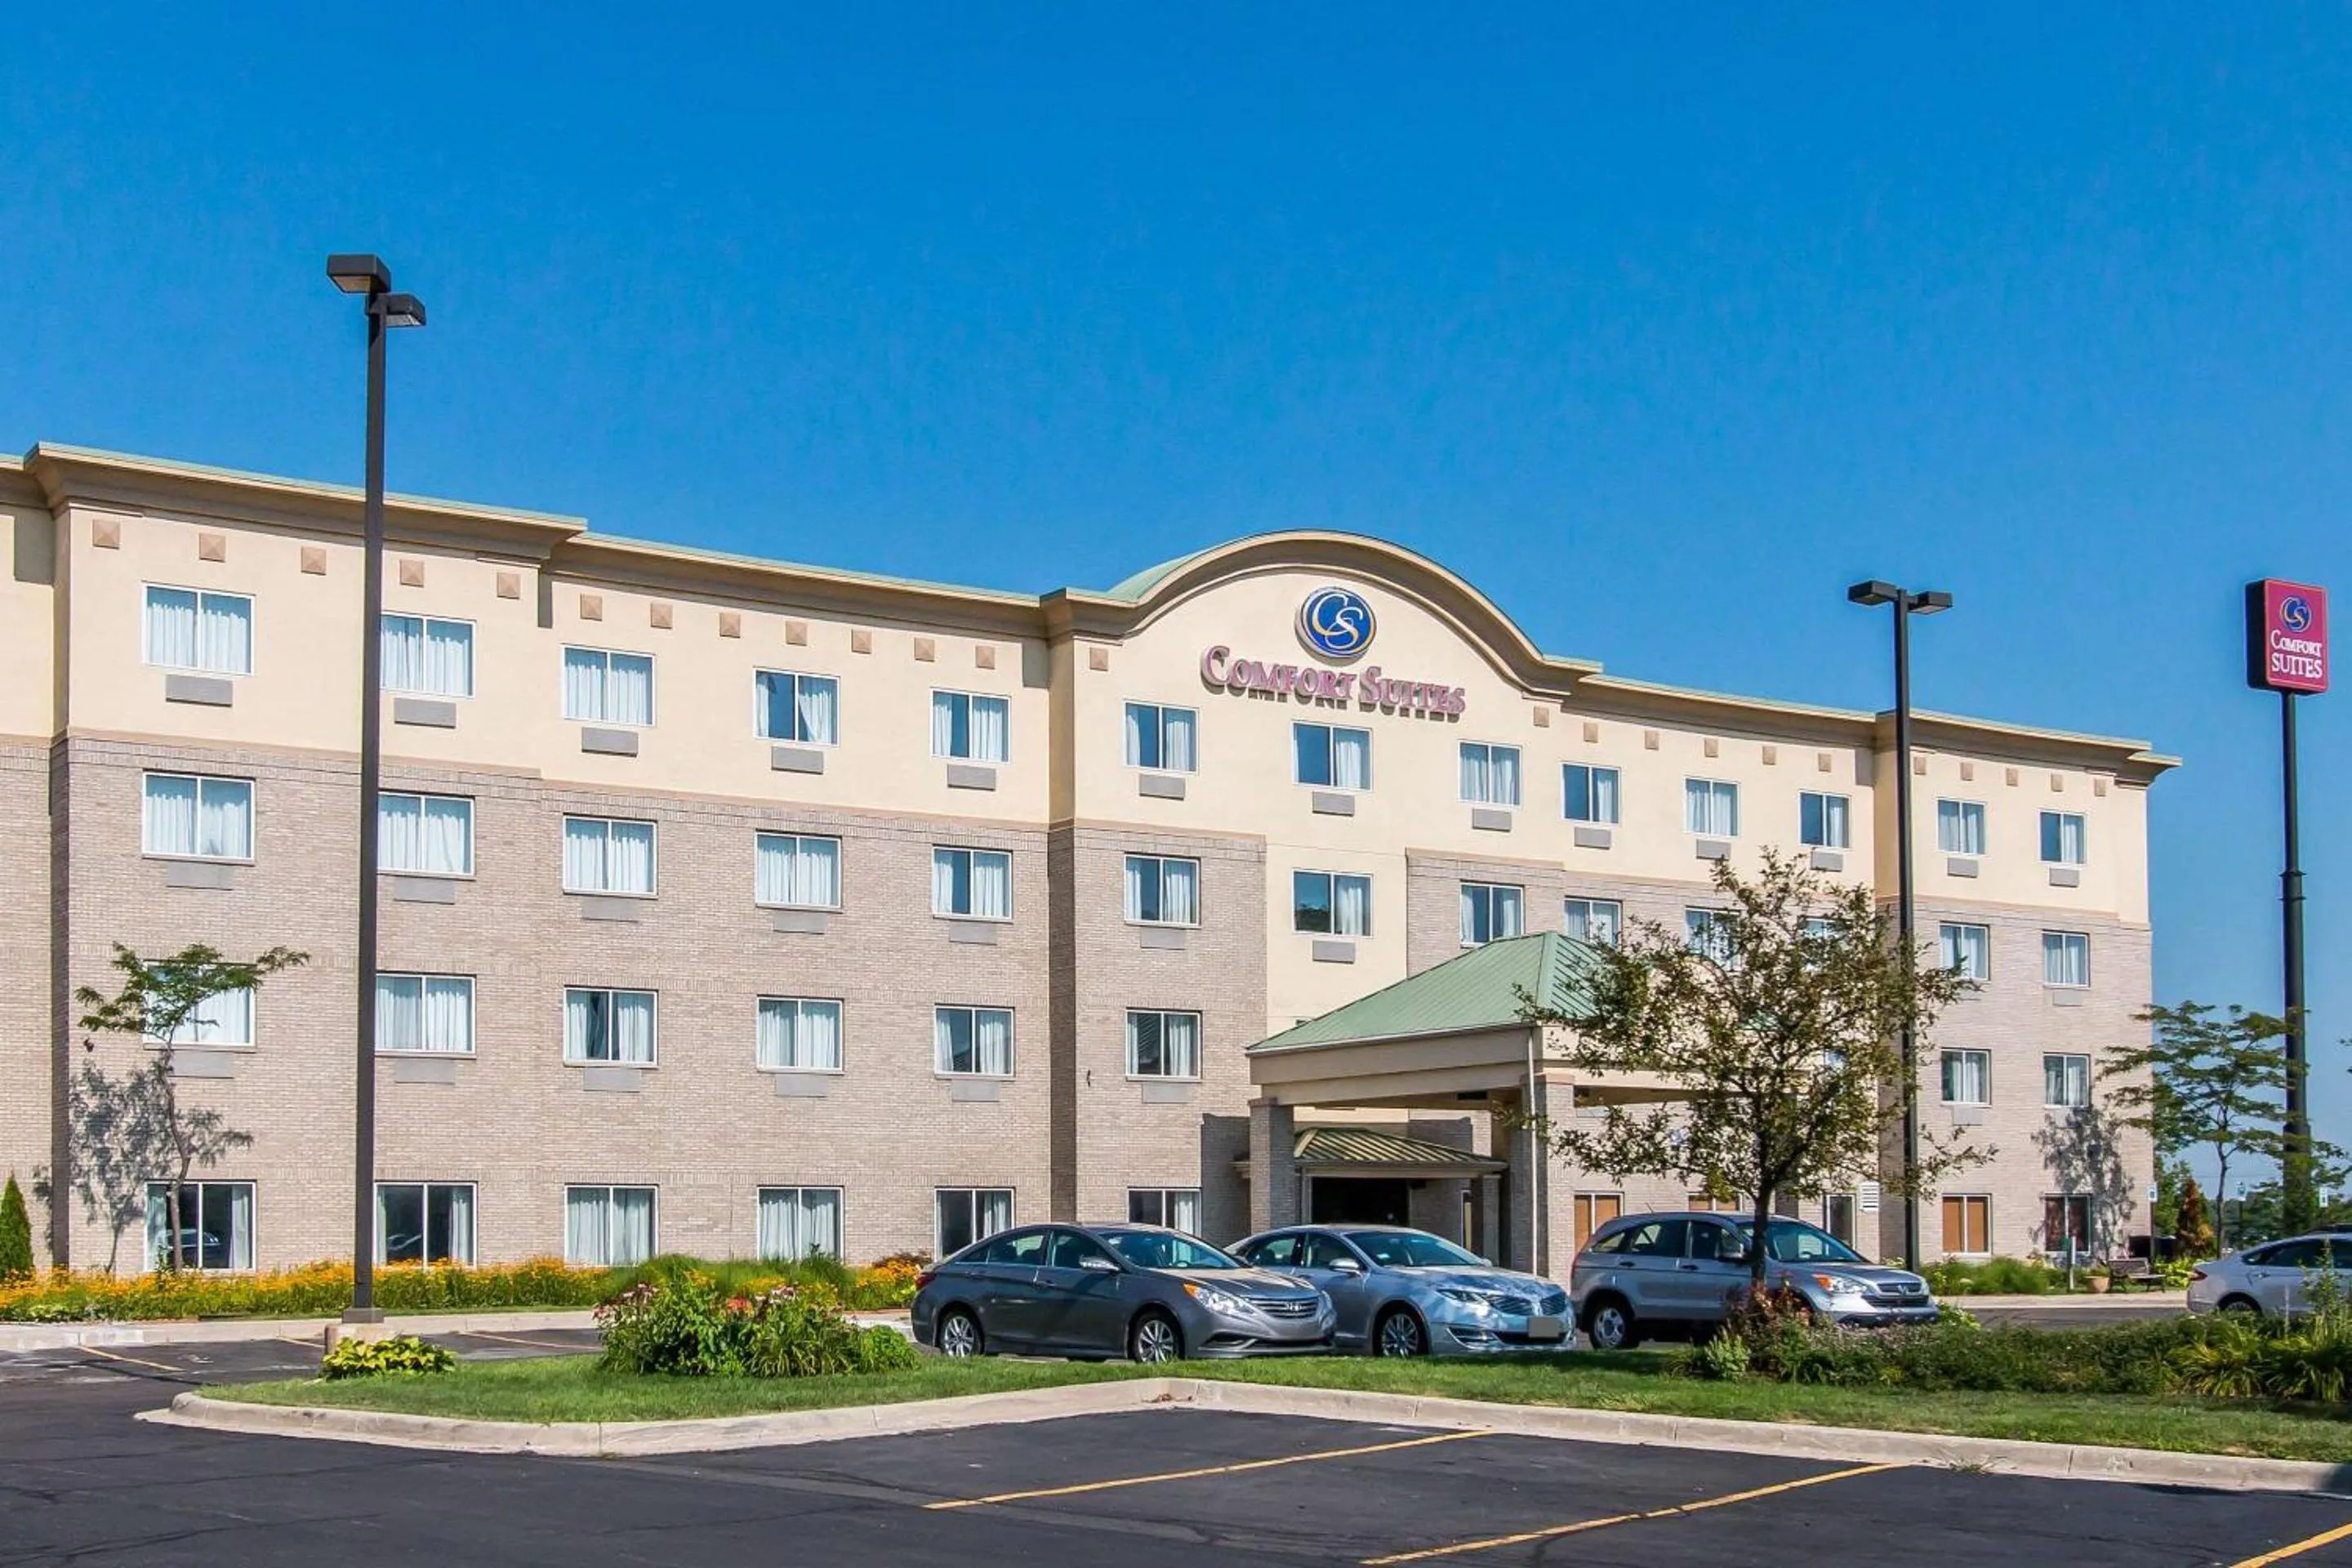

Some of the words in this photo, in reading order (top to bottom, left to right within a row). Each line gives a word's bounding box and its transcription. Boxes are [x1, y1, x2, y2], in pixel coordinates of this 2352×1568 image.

[2270, 630, 2322, 657] COMFORT
[2271, 653, 2323, 678] SUITES
[1203, 644, 1357, 702] COMFORT
[1360, 666, 1466, 715] SUITES
